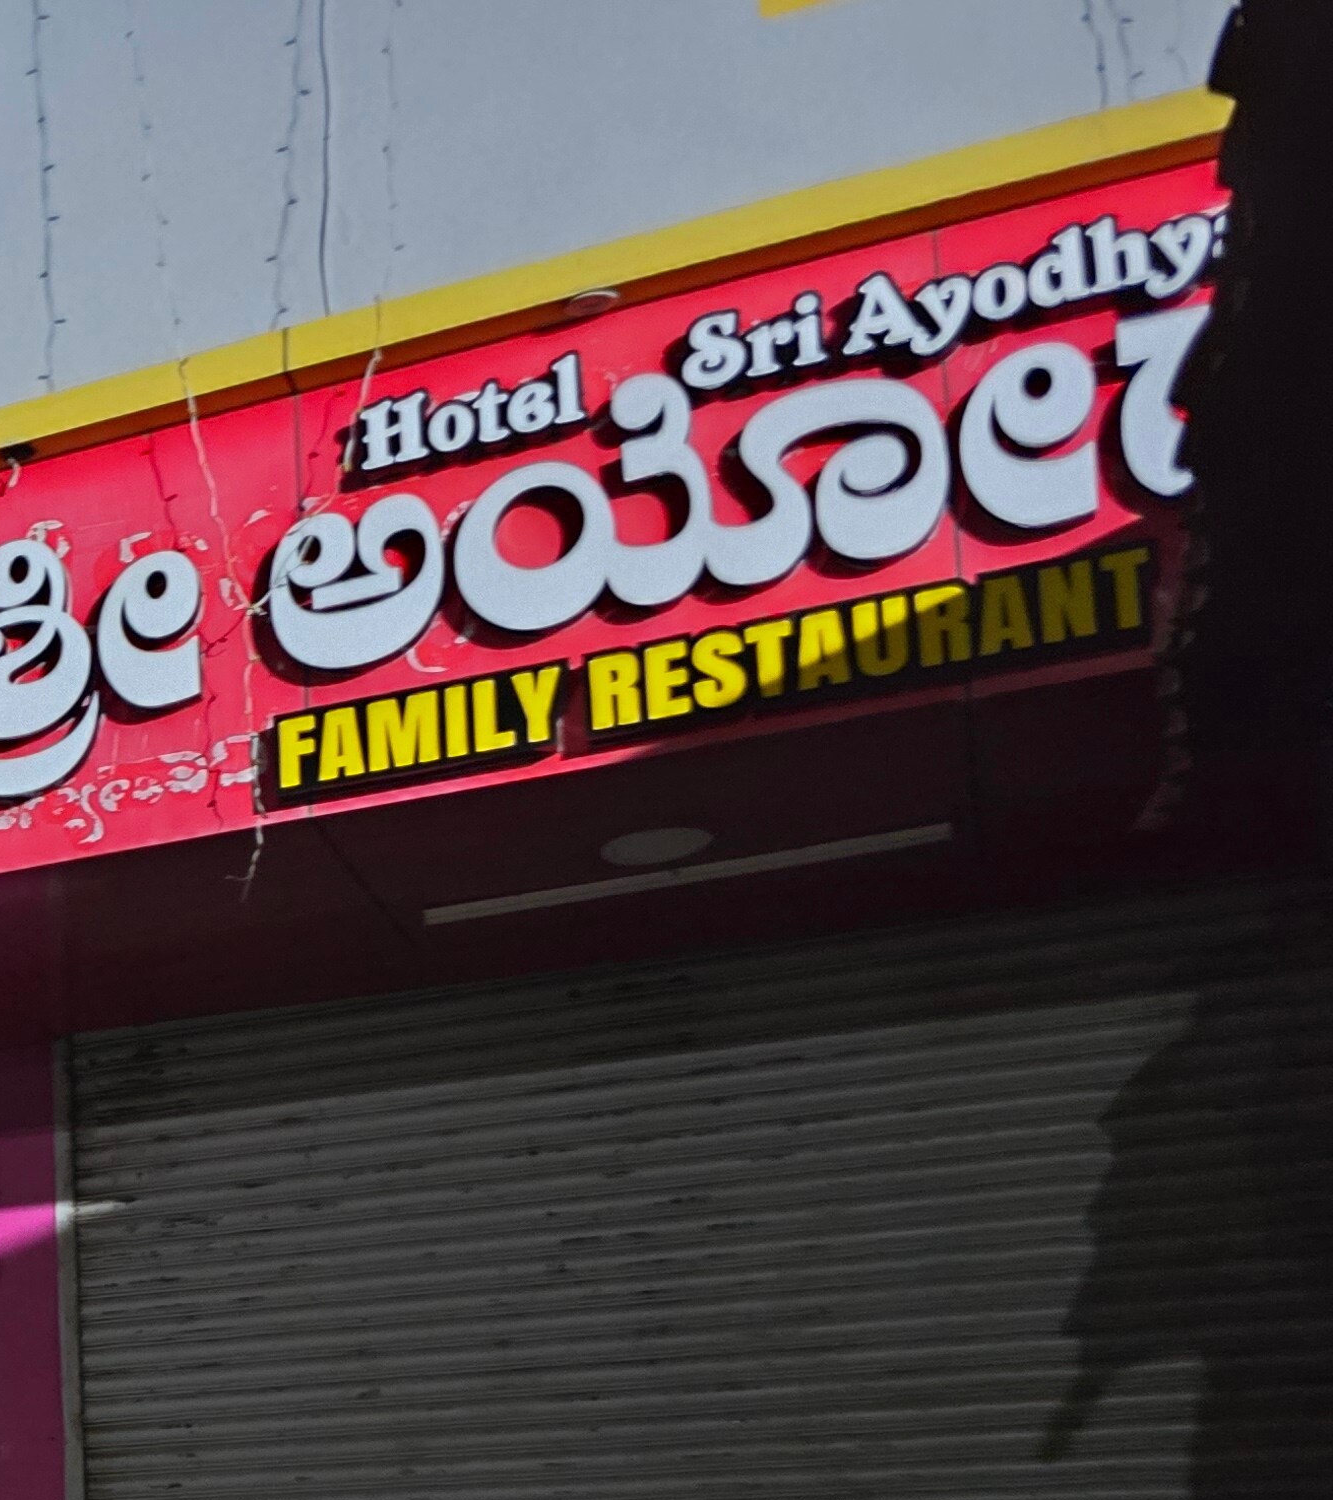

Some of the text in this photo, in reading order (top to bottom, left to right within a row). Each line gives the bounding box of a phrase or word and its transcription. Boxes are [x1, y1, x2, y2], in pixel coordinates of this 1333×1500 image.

[360, 213, 1228, 471] Hotel Sri Ayodhy
[278, 663, 565, 791] FAMILY
[589, 546, 1151, 732] RESTAURANT
